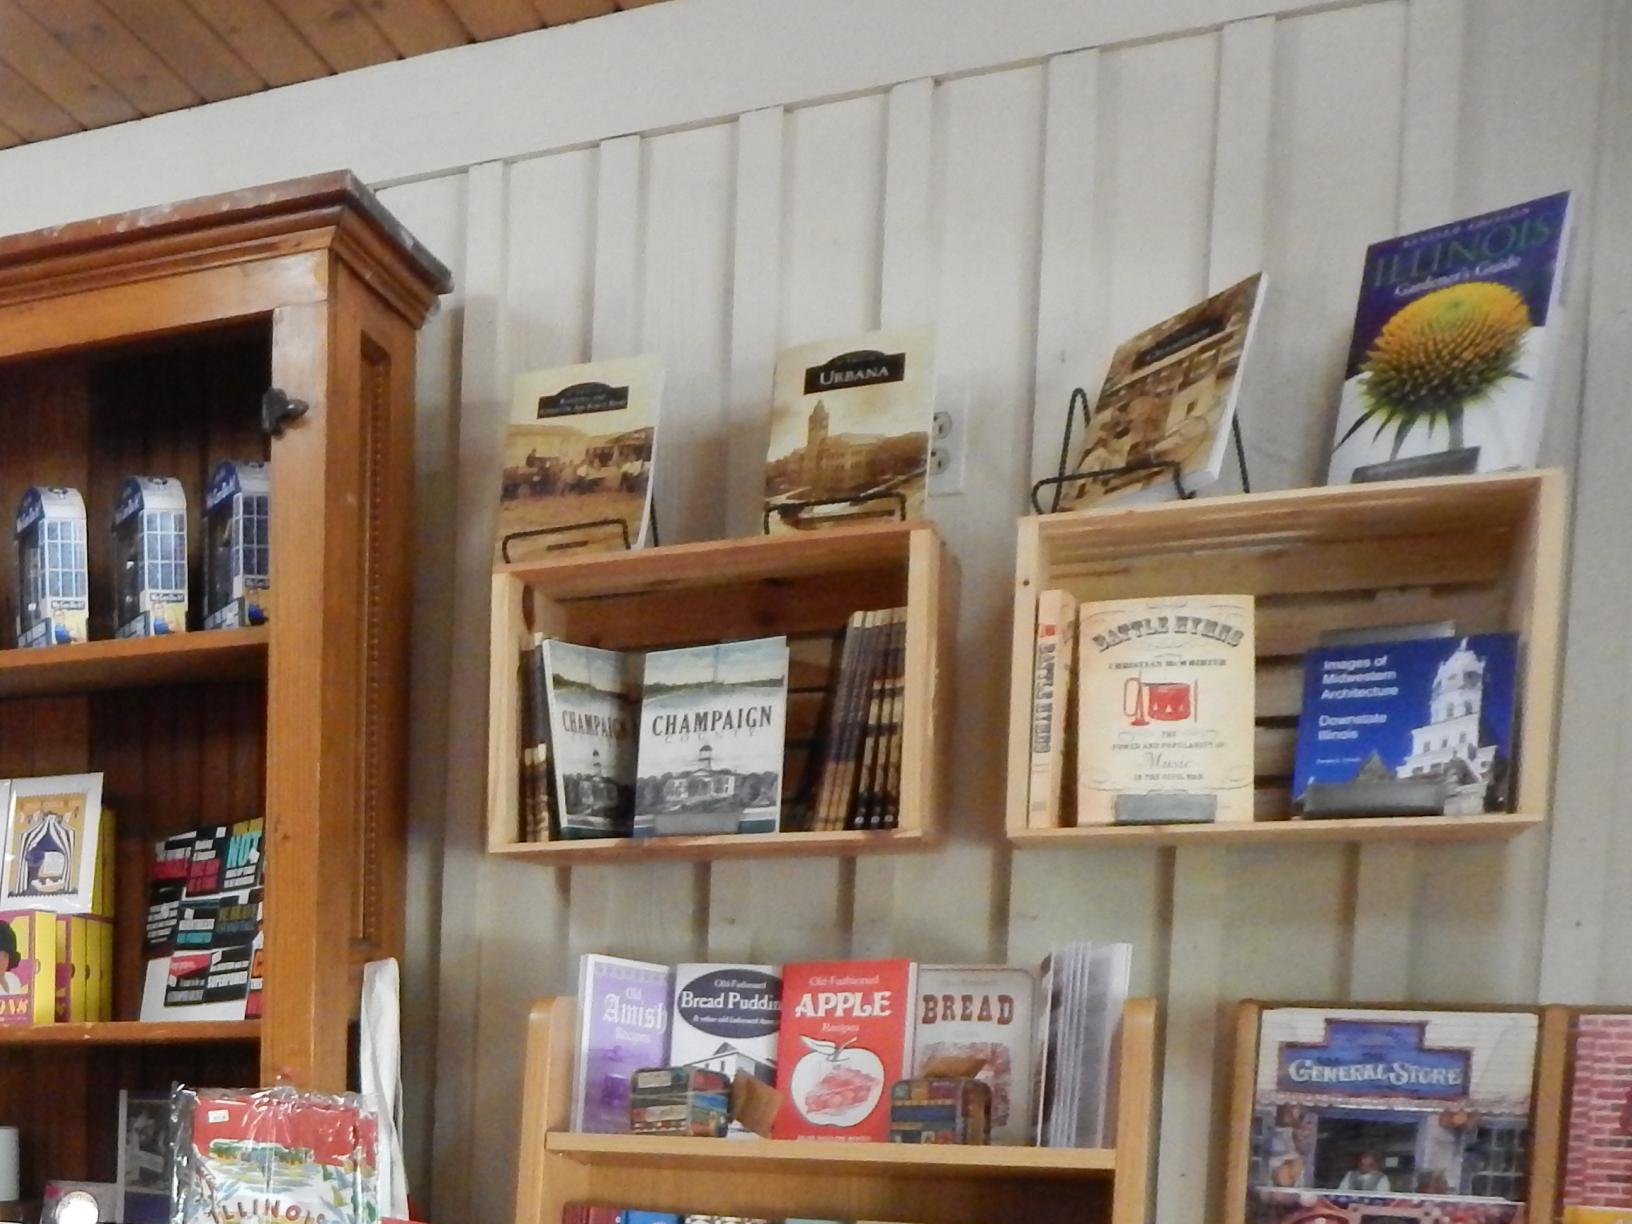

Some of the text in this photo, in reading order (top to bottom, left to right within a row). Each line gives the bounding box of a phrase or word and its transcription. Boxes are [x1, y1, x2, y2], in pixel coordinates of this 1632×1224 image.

[1376, 216, 1550, 287] ILLINOIS
[1093, 616, 1245, 653] BATTLE HYMNS
[1323, 655, 1388, 671] Images of
[1320, 687, 1399, 699] Architecture
[652, 705, 773, 737] CHAMPAIGN
[1318, 714, 1388, 727] Downstate
[603, 993, 668, 1031] Amish
[681, 990, 725, 1010] Bread
[795, 991, 892, 1018] APPLE
[922, 994, 1015, 1025] BREAD
[1289, 1059, 1461, 1085] GENERAL STORE
